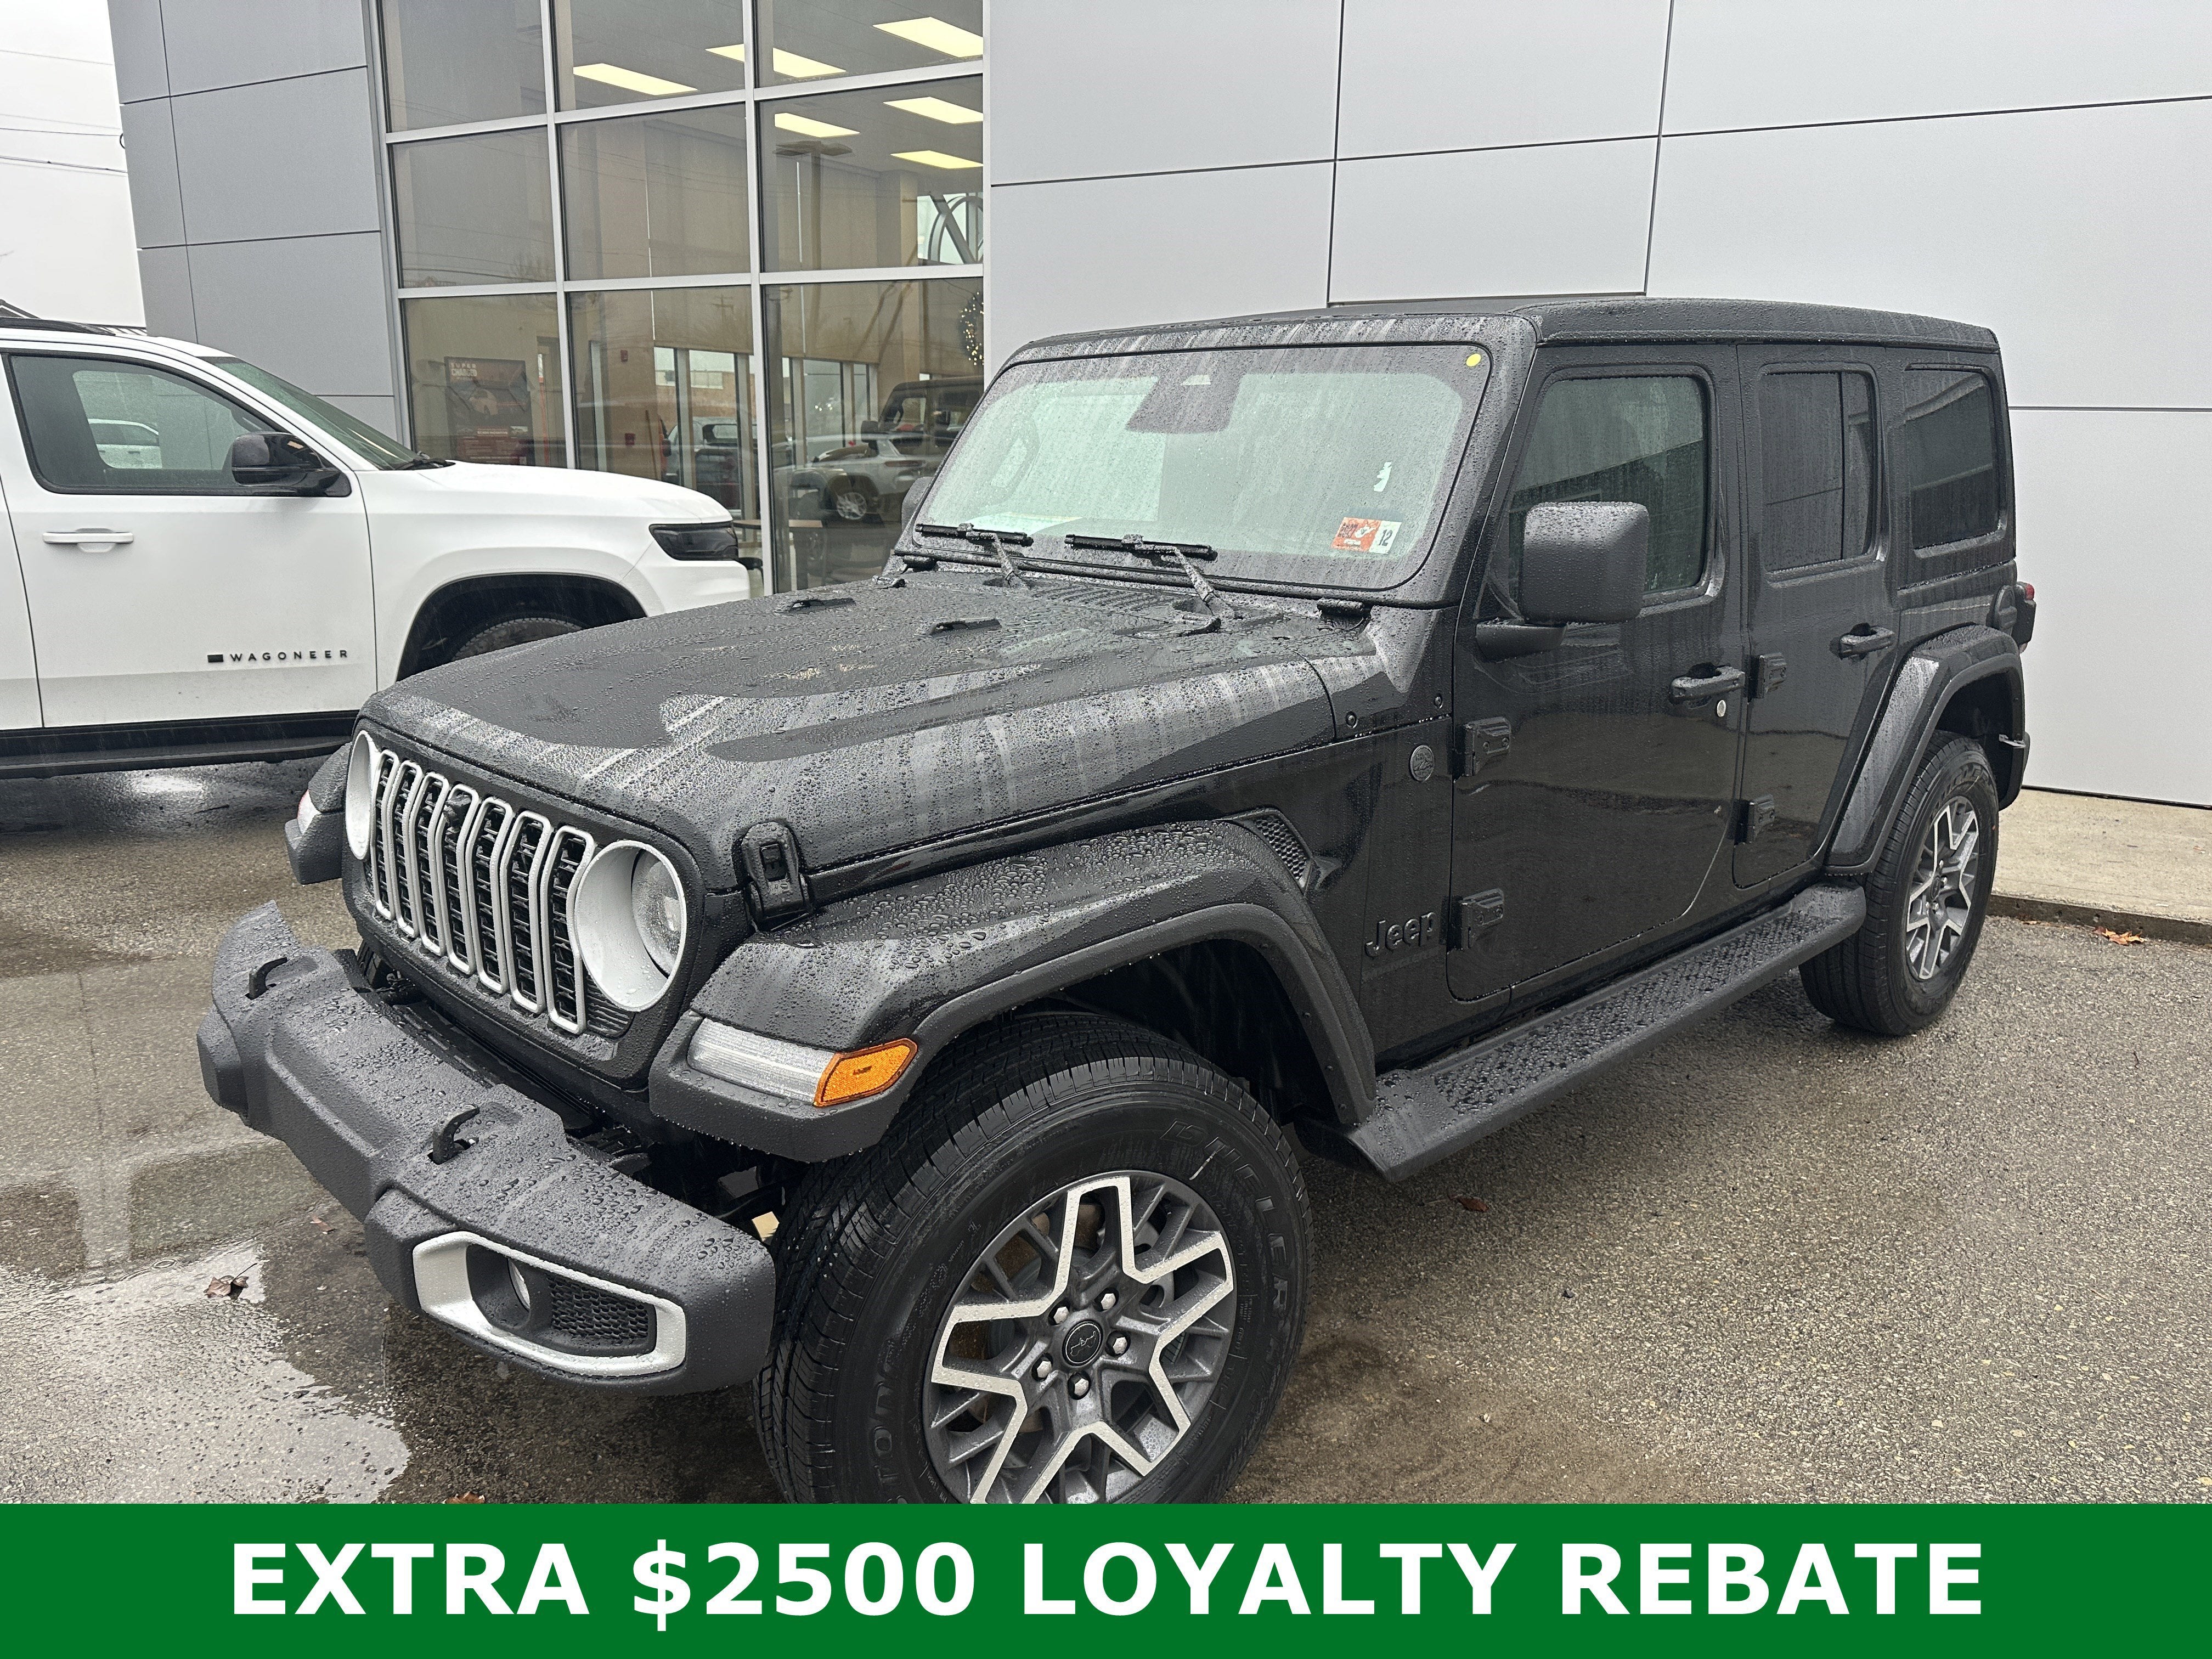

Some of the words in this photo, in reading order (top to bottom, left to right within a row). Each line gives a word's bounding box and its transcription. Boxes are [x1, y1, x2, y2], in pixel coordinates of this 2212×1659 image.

[1378, 529, 1393, 546] 12
[230, 650, 348, 662] WAGONEER
[1364, 911, 1438, 957] Jeep
